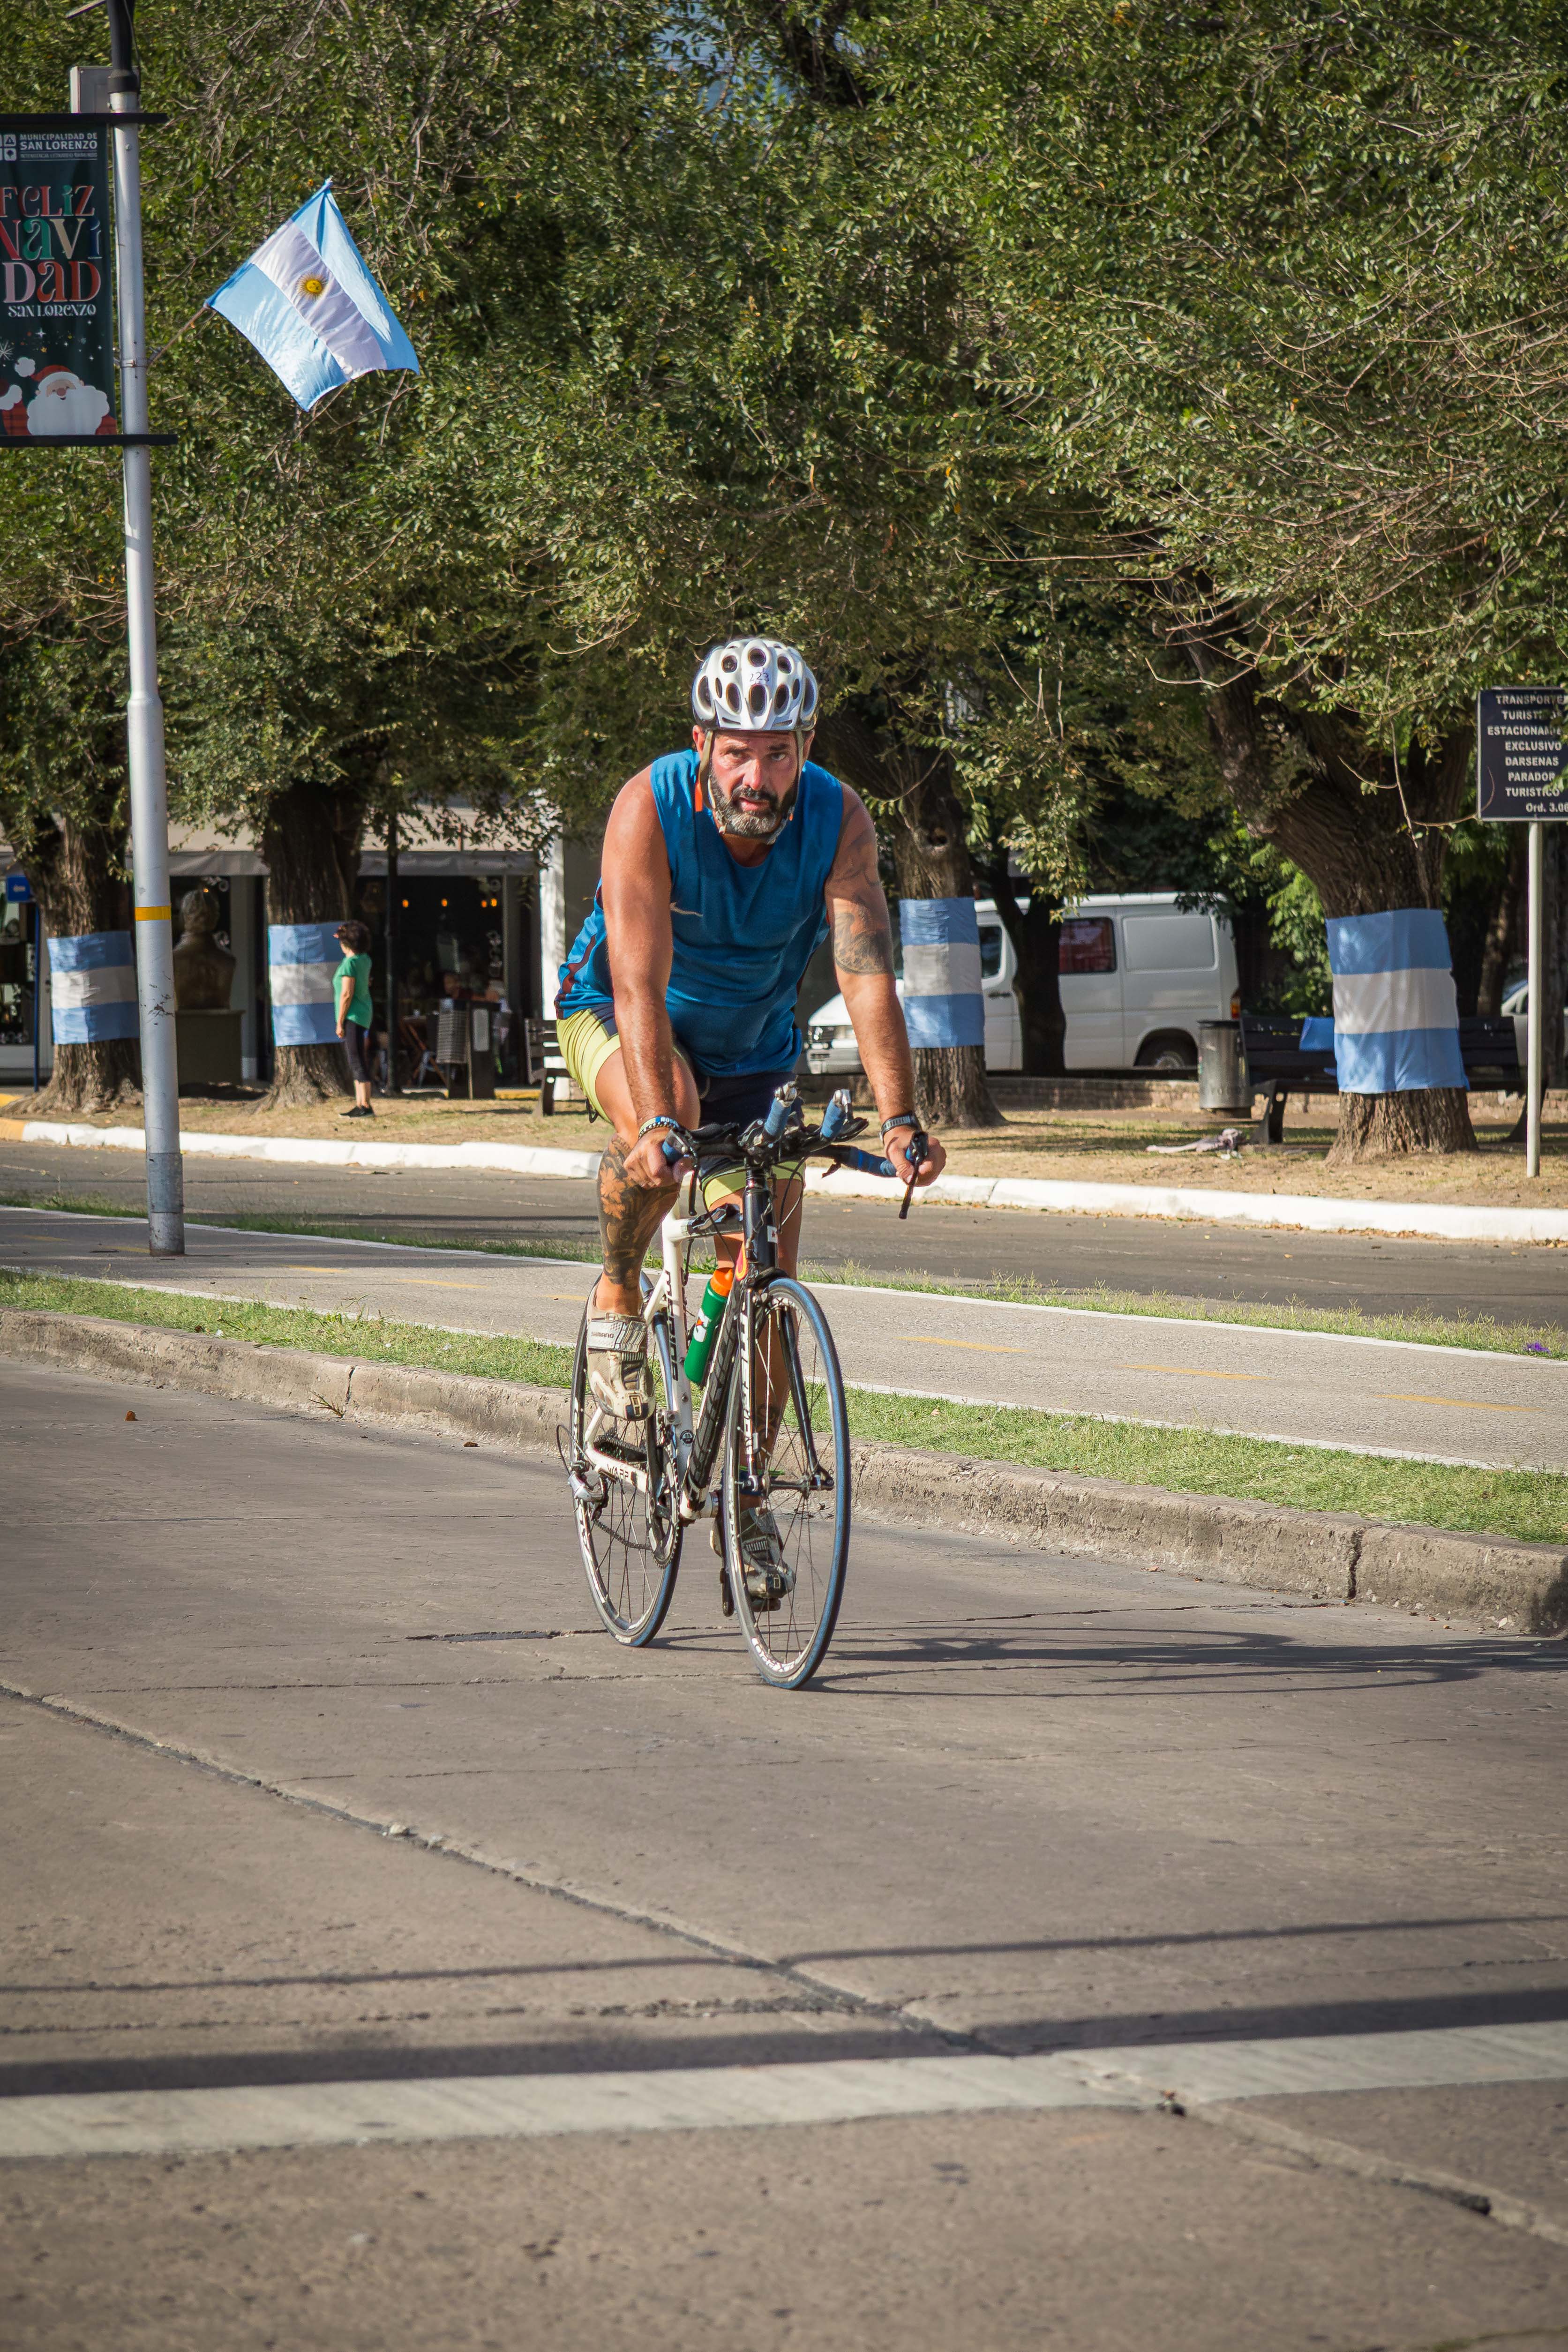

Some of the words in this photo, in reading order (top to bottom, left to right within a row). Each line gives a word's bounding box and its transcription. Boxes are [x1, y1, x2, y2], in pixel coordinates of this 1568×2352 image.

[20, 142, 43, 150] SAN
[46, 141, 98, 150] LORENZO
[1496, 695, 1567, 704] TRANSPORTE
[1505, 741, 1562, 751] EXCLUSIVO
[1505, 757, 1559, 766] DARSENAS
[1508, 772, 1555, 782] PARADOR
[1505, 787, 1560, 797] TURISTICO
[1526, 802, 1546, 812] Ord.
